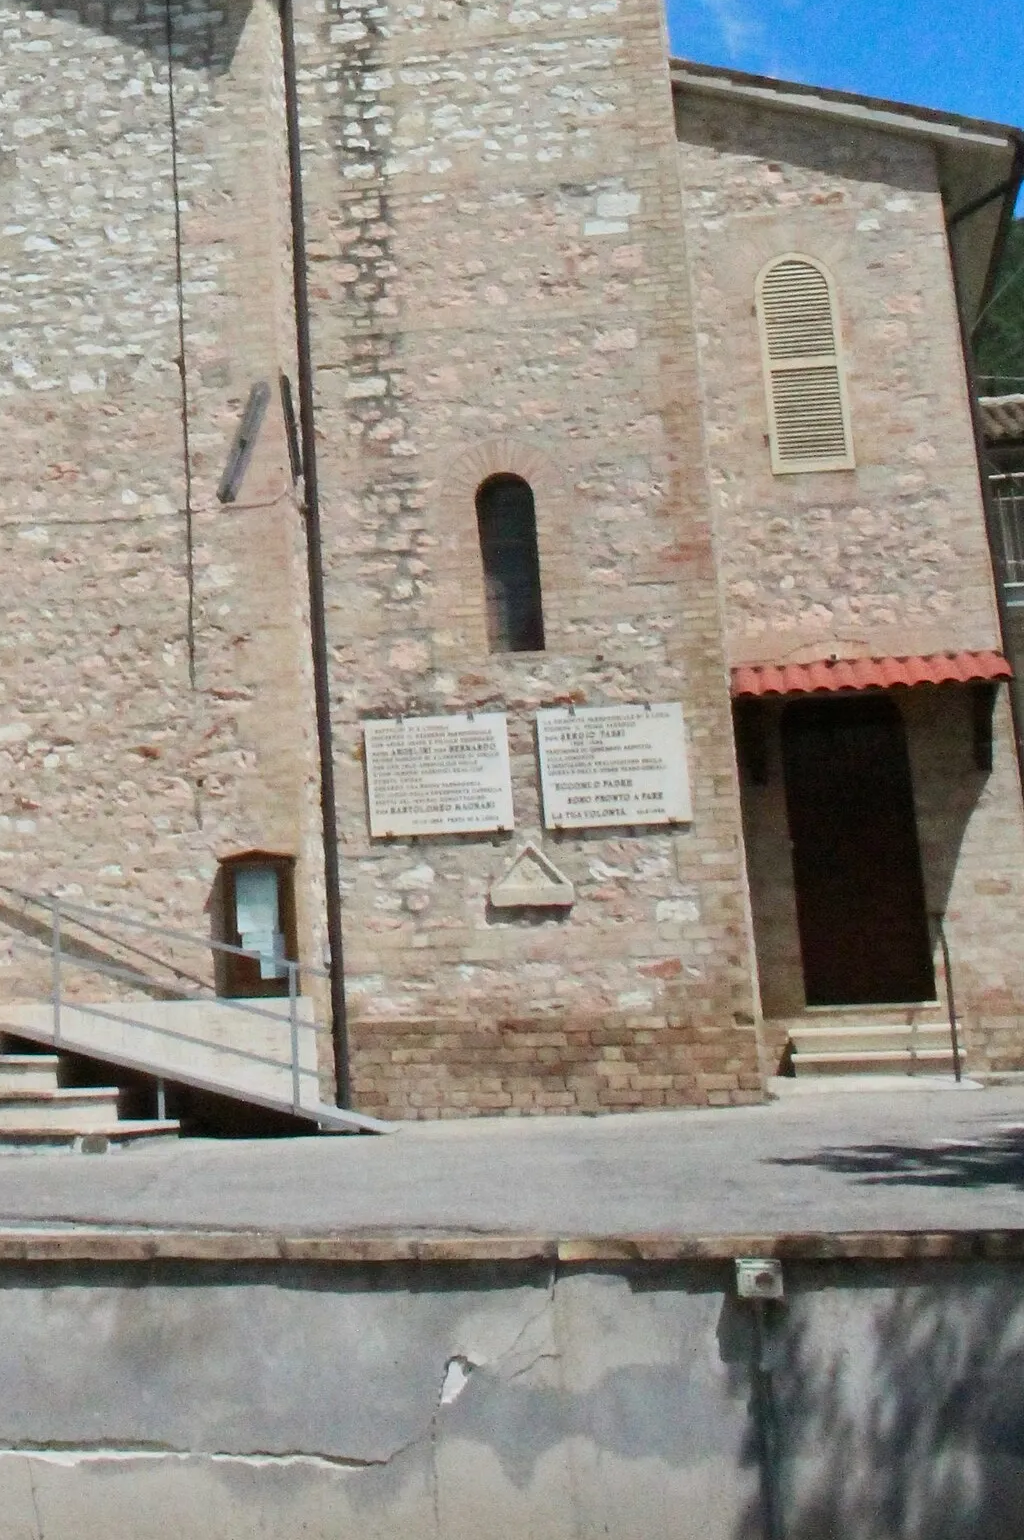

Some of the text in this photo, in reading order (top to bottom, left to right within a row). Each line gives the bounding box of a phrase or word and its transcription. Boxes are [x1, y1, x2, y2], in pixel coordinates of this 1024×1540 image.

[448, 742, 496, 752] BERNARDO
[603, 779, 632, 787] PADRE
[567, 795, 591, 804] SONO
[594, 793, 630, 802] PRONTO
[390, 804, 452, 813] BARTOLOMEO
